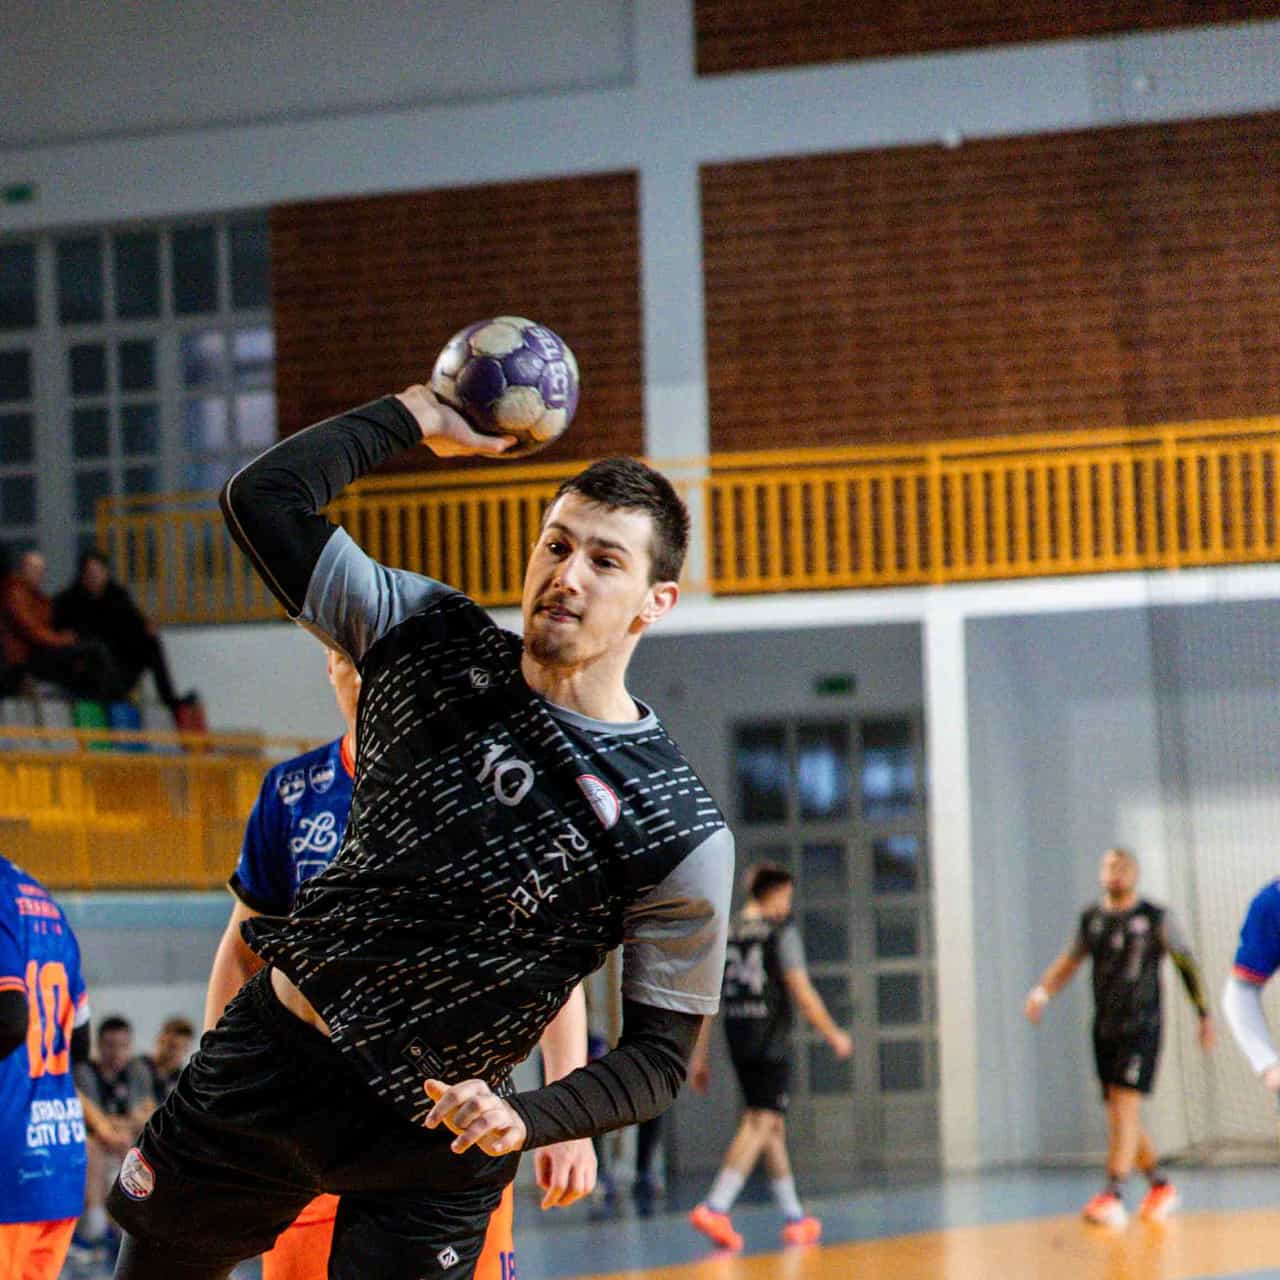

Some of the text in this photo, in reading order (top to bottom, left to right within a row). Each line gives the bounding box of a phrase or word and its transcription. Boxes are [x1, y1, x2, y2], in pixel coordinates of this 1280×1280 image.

[476, 743, 535, 807] 10
[543, 822, 589, 872] RK
[26, 959, 75, 1078] 10
